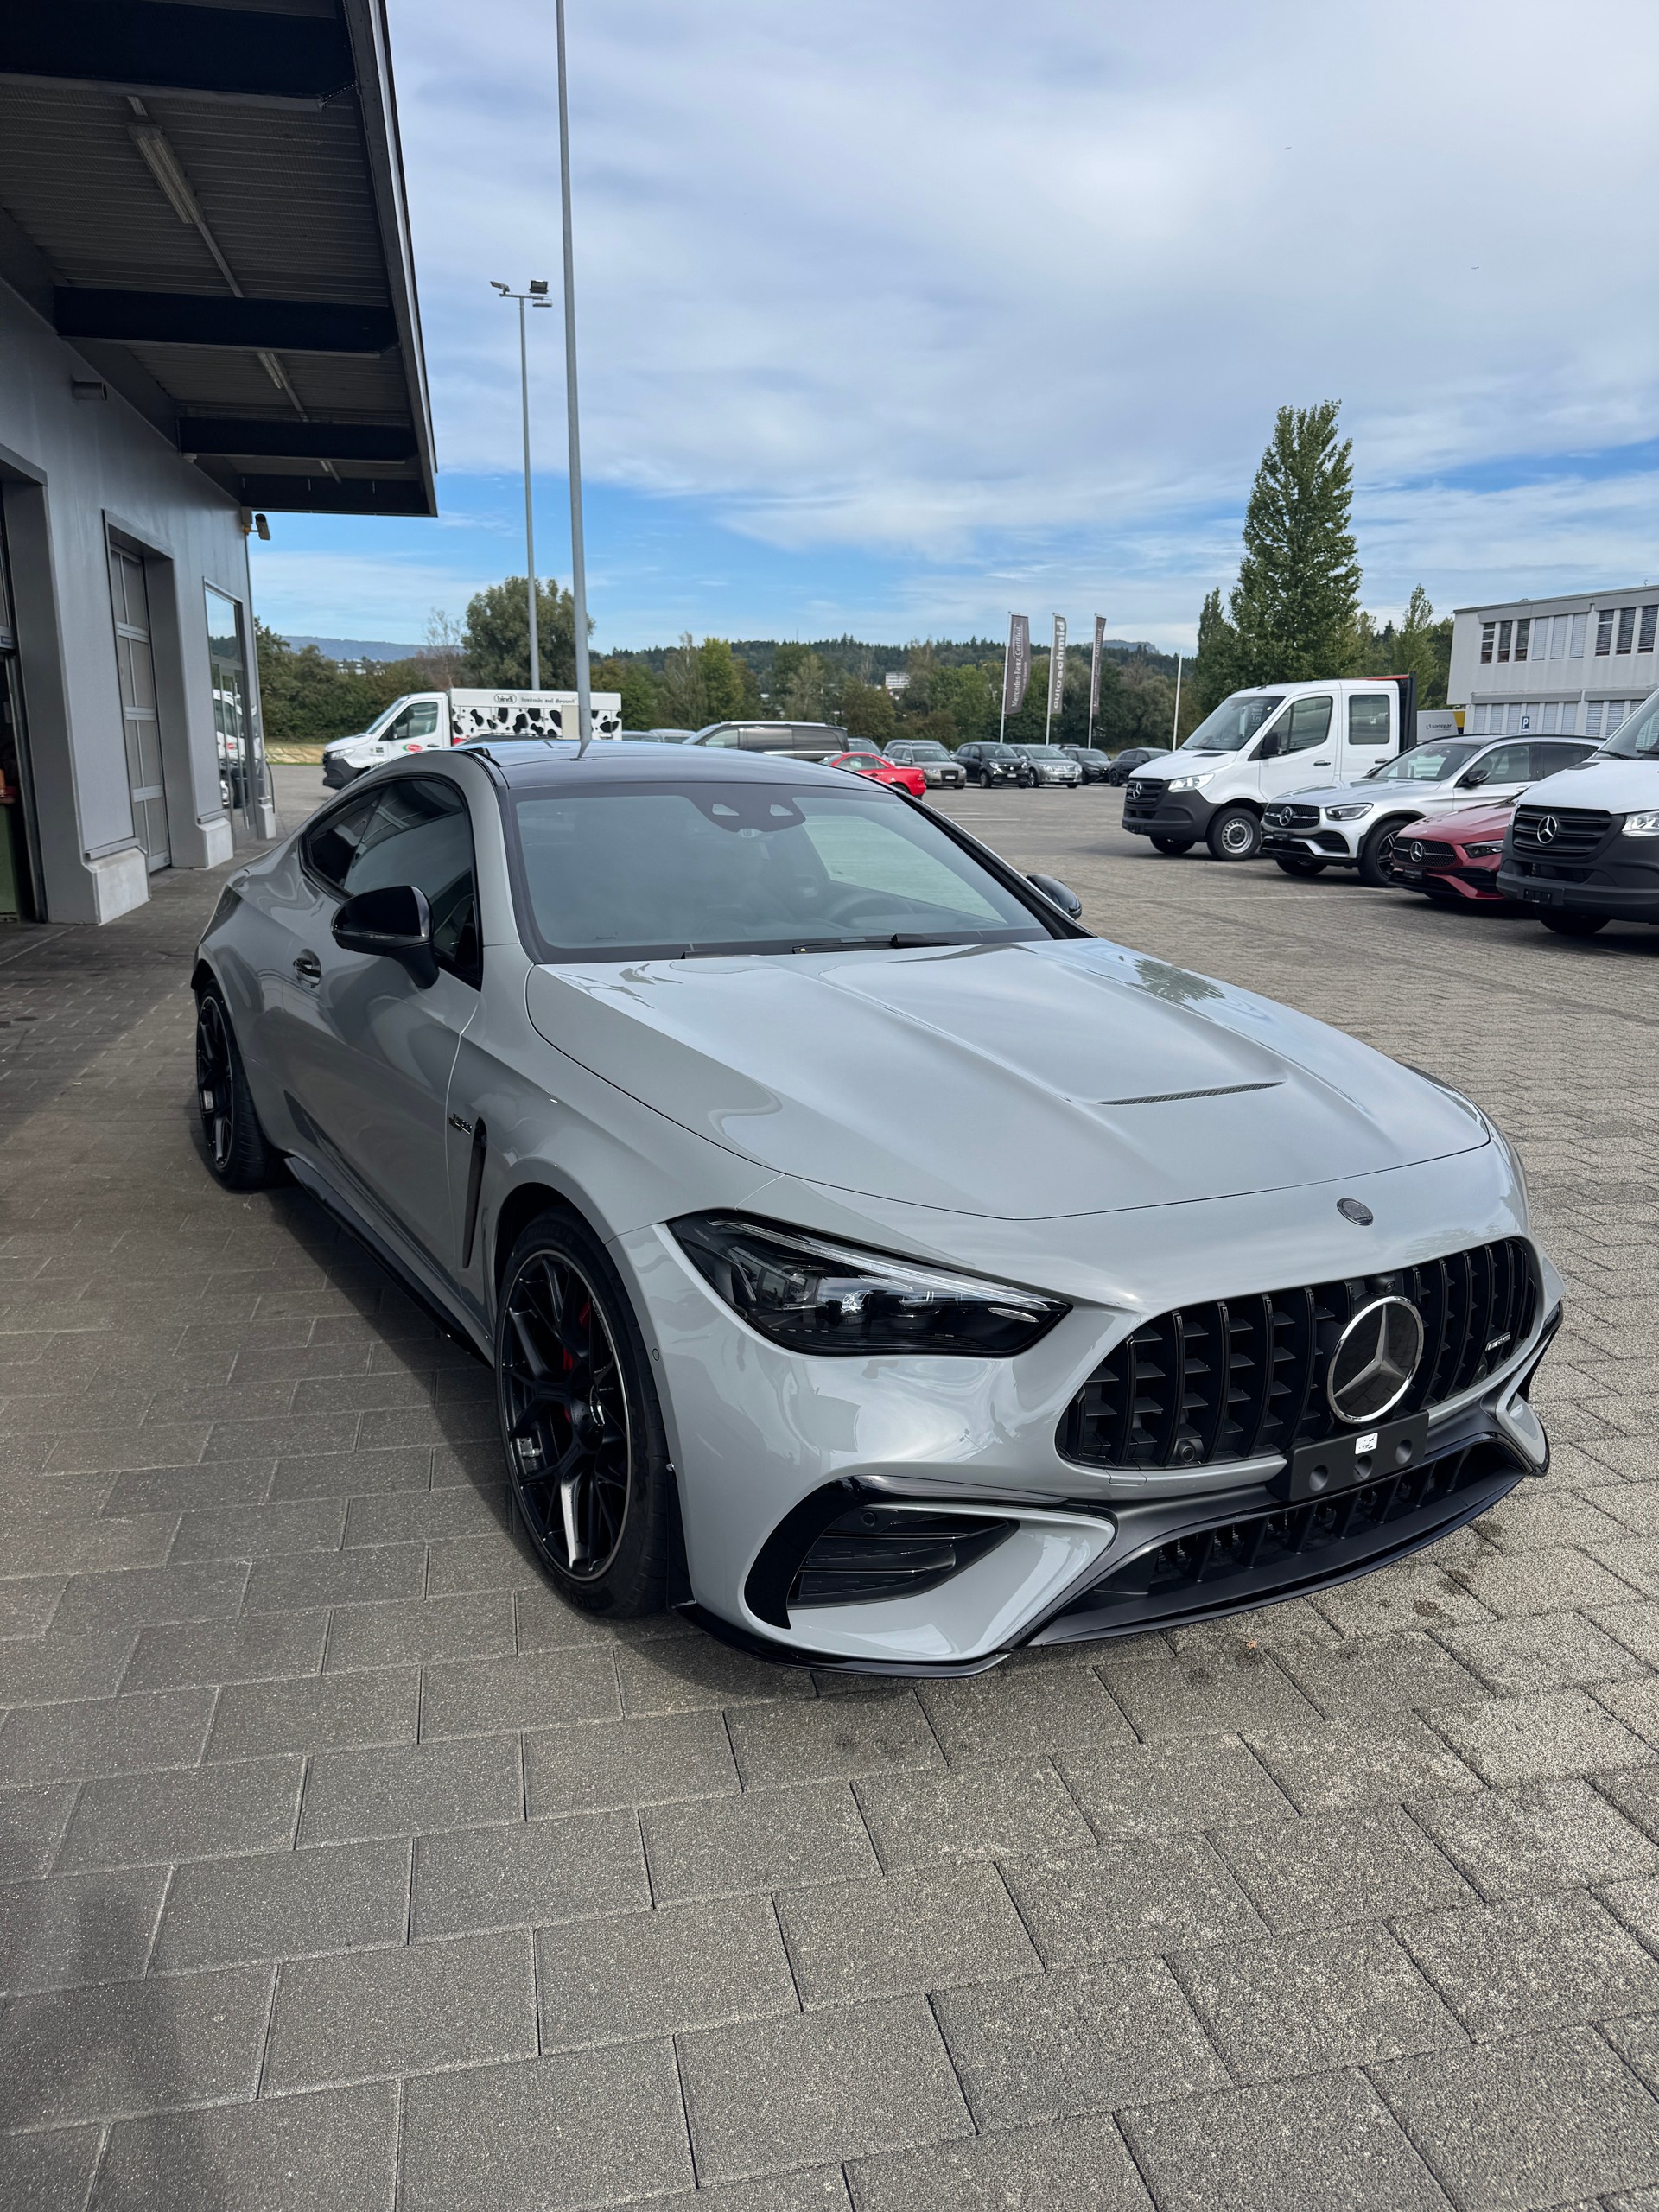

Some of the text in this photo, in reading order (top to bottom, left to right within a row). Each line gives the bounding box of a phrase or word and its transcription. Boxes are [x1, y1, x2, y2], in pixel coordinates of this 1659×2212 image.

[1053, 621, 1065, 709] autoschmid
[1011, 658, 1022, 707] Mercedes-Benz
[496, 695, 514, 703] bindi
[1522, 717, 1529, 728] P
